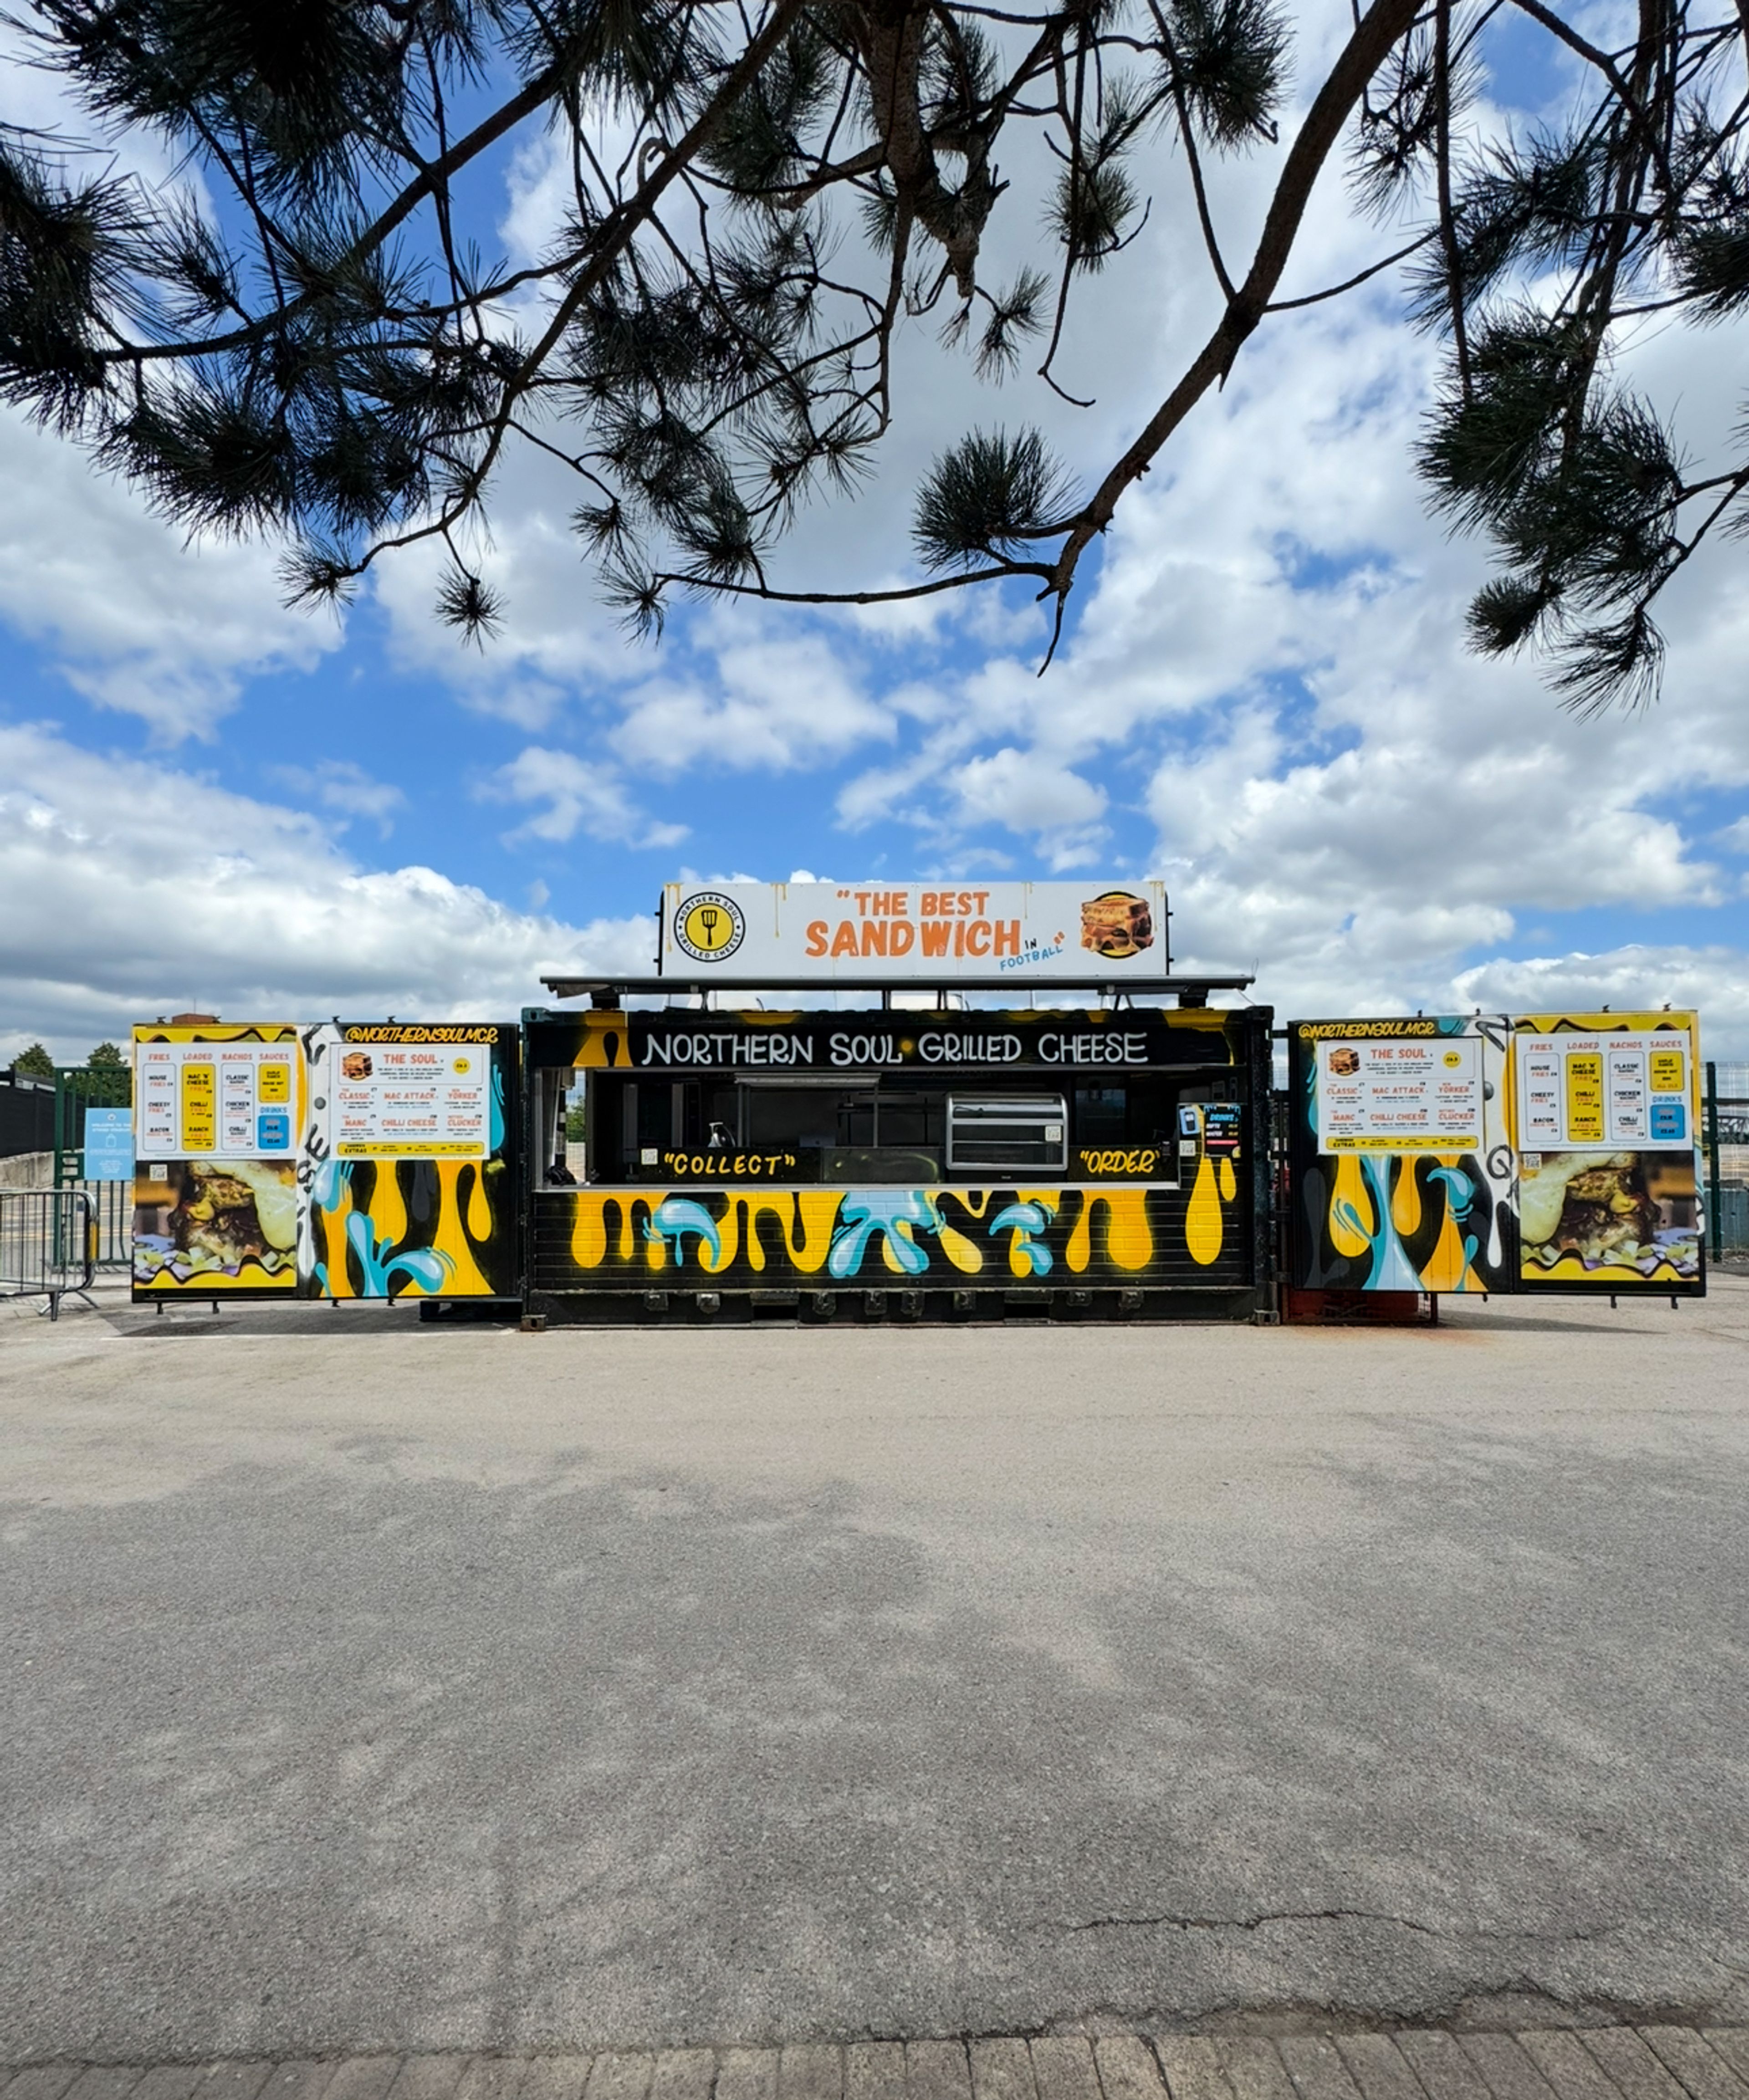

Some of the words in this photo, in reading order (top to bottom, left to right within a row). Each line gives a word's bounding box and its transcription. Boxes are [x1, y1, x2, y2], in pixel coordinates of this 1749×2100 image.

[679, 896, 721, 921] NORTHERN
[724, 901, 740, 920] SOUL
[921, 892, 990, 916] BEST
[679, 933, 710, 959] GRILLED
[714, 934, 741, 958] CHEESE
[806, 920, 1021, 957] SANDWICH
[1024, 938, 1037, 950] IN
[345, 1027, 498, 1043] @NORTHERNSOULMCR
[1299, 1022, 1435, 1038] @NORTHERNSOULMCR
[384, 1054, 406, 1064] THE
[410, 1054, 438, 1064] SOUL
[642, 1034, 813, 1065] NORTHERN
[830, 1033, 903, 1066] SOUL
[918, 1032, 1022, 1063] GRILLED
[1038, 1032, 1149, 1063] CHEESE
[1371, 1049, 1393, 1058] THE
[1399, 1049, 1426, 1058] SOUL
[665, 1152, 795, 1175] "COLLECT"
